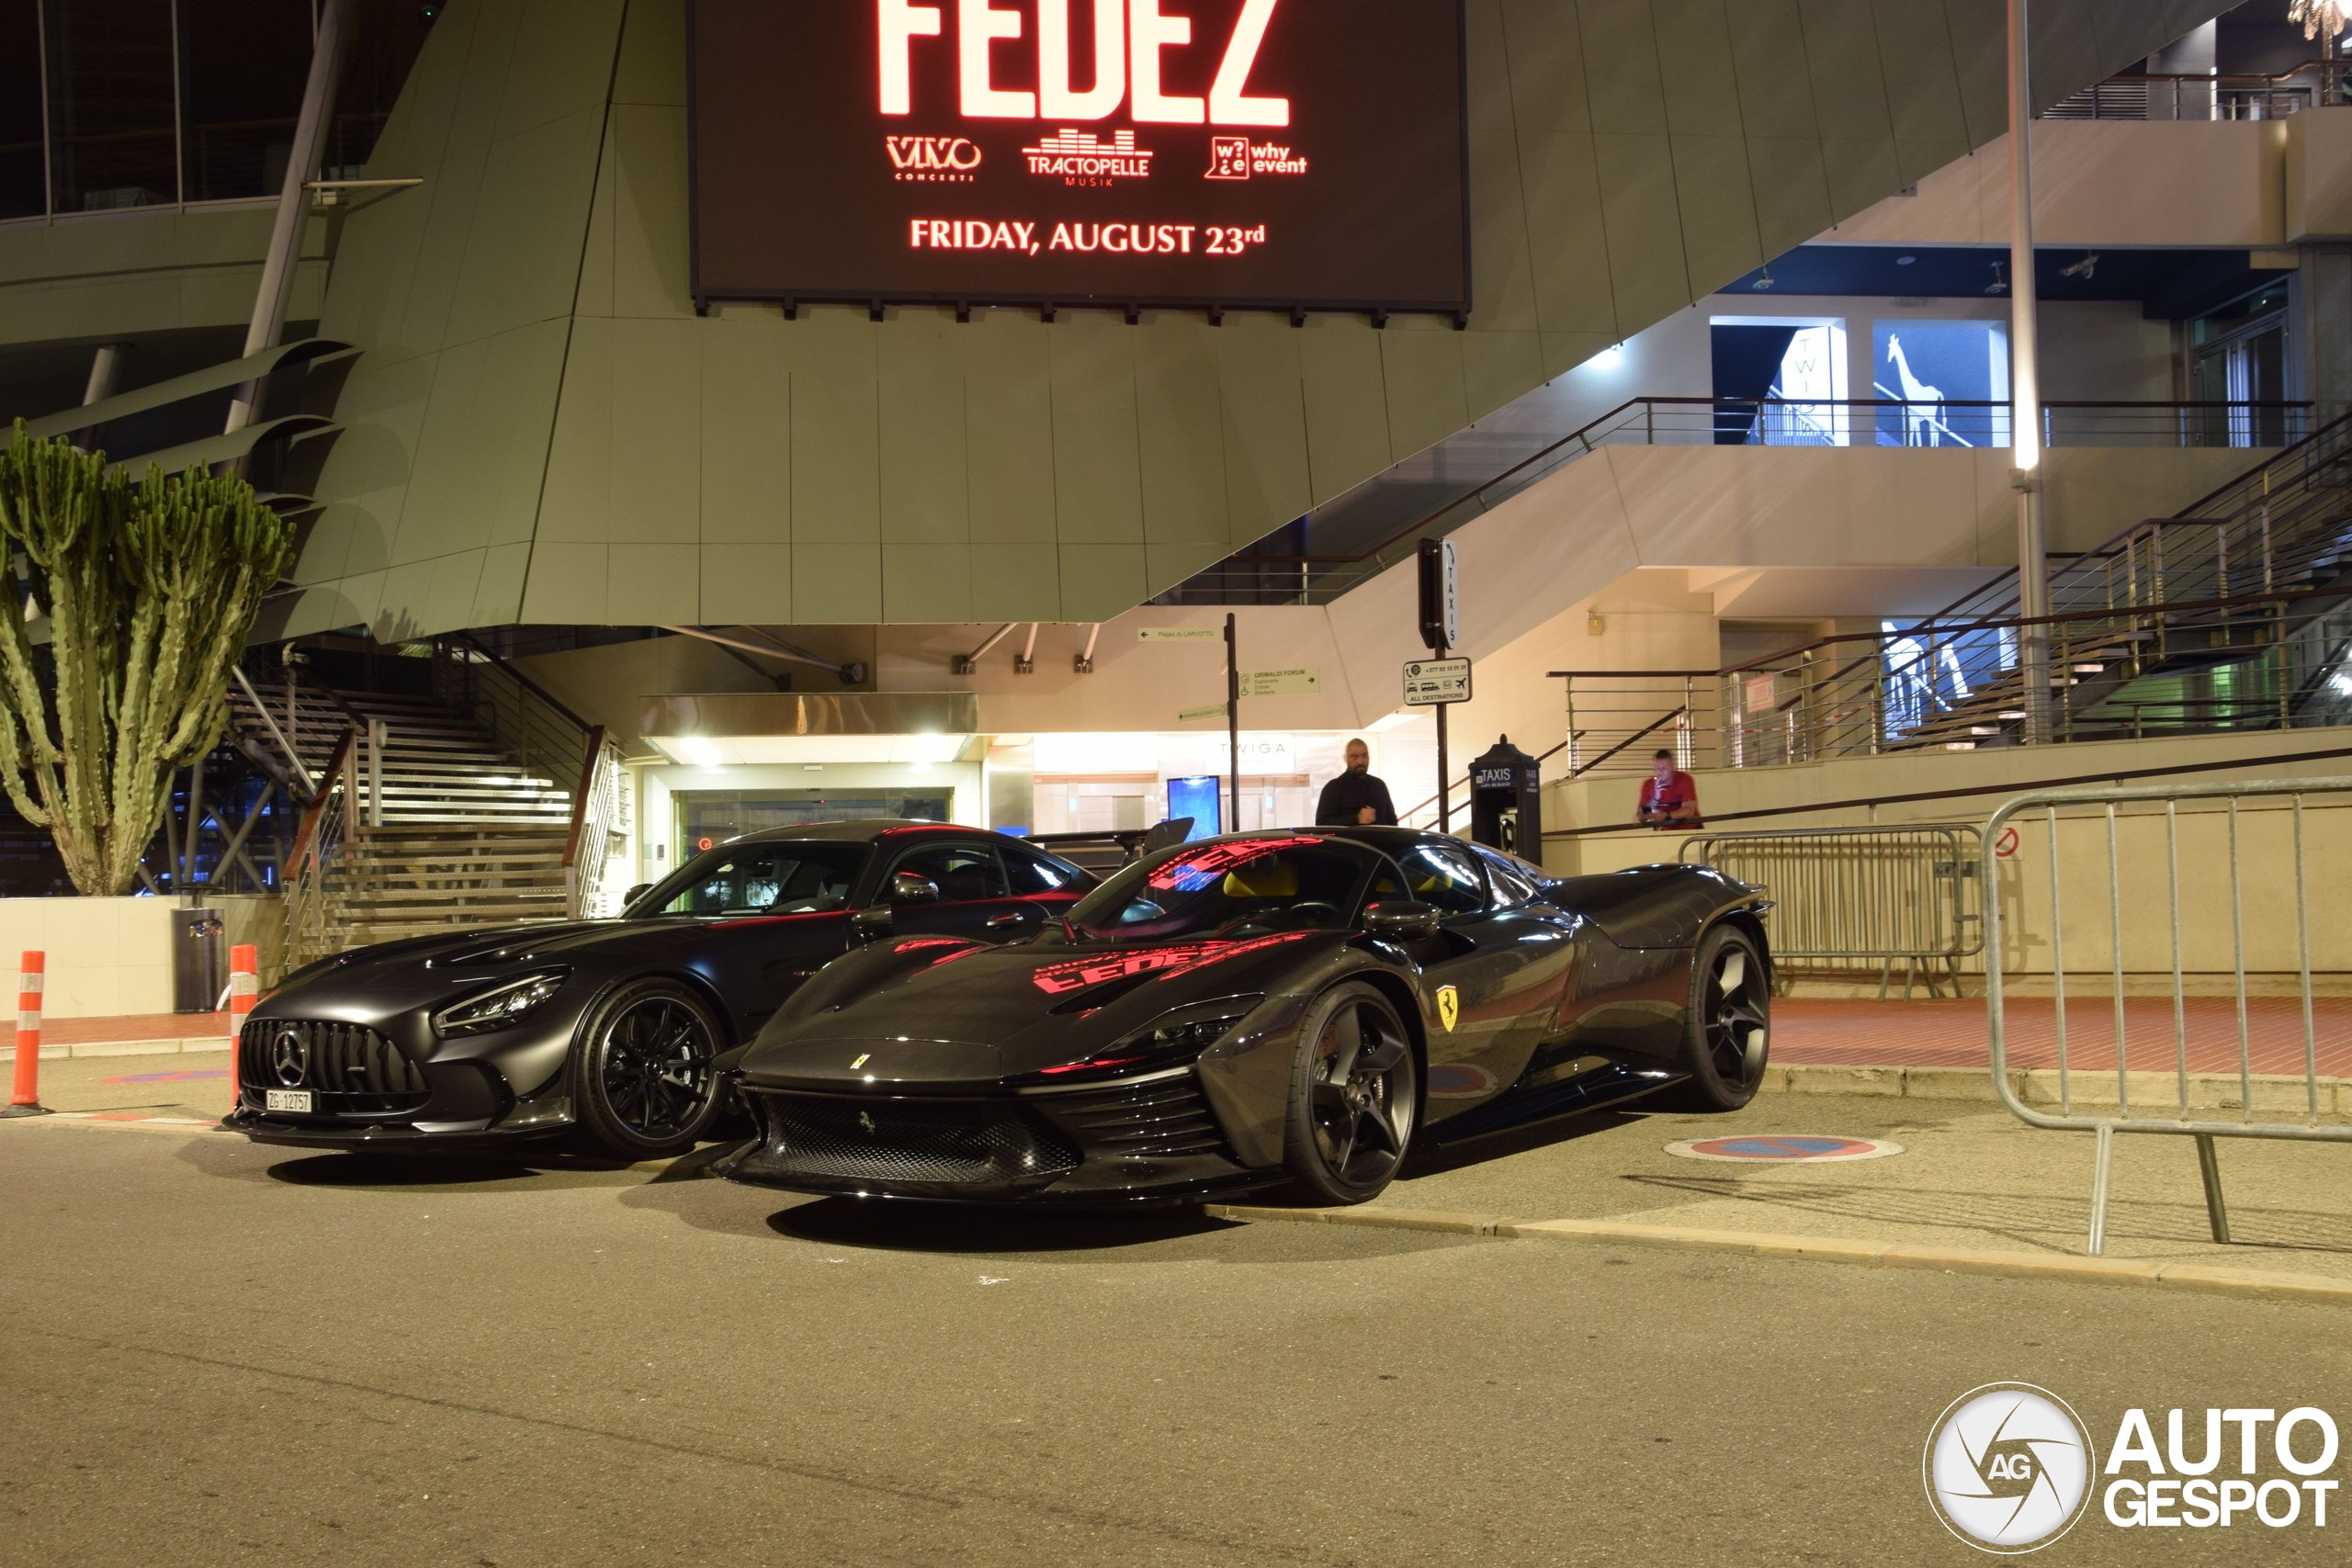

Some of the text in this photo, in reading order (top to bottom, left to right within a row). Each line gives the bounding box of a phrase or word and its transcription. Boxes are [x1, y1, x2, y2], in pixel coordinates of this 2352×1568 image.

[878, 0, 1290, 127] FEDEZ
[886, 136, 982, 170] VIVO
[1250, 142, 1290, 161] why
[1027, 156, 1149, 176] TRACTOPELLE
[1253, 157, 1307, 174] event
[895, 173, 974, 182] CONCERTI
[1065, 176, 1114, 187] MUSIK
[910, 220, 1265, 256] FRIDAY, AUGUST 23rd
[1422, 693, 1464, 701] DESTINATIONS
[1218, 742, 1286, 754] TWIGA
[1480, 768, 1511, 782] TAXIS
